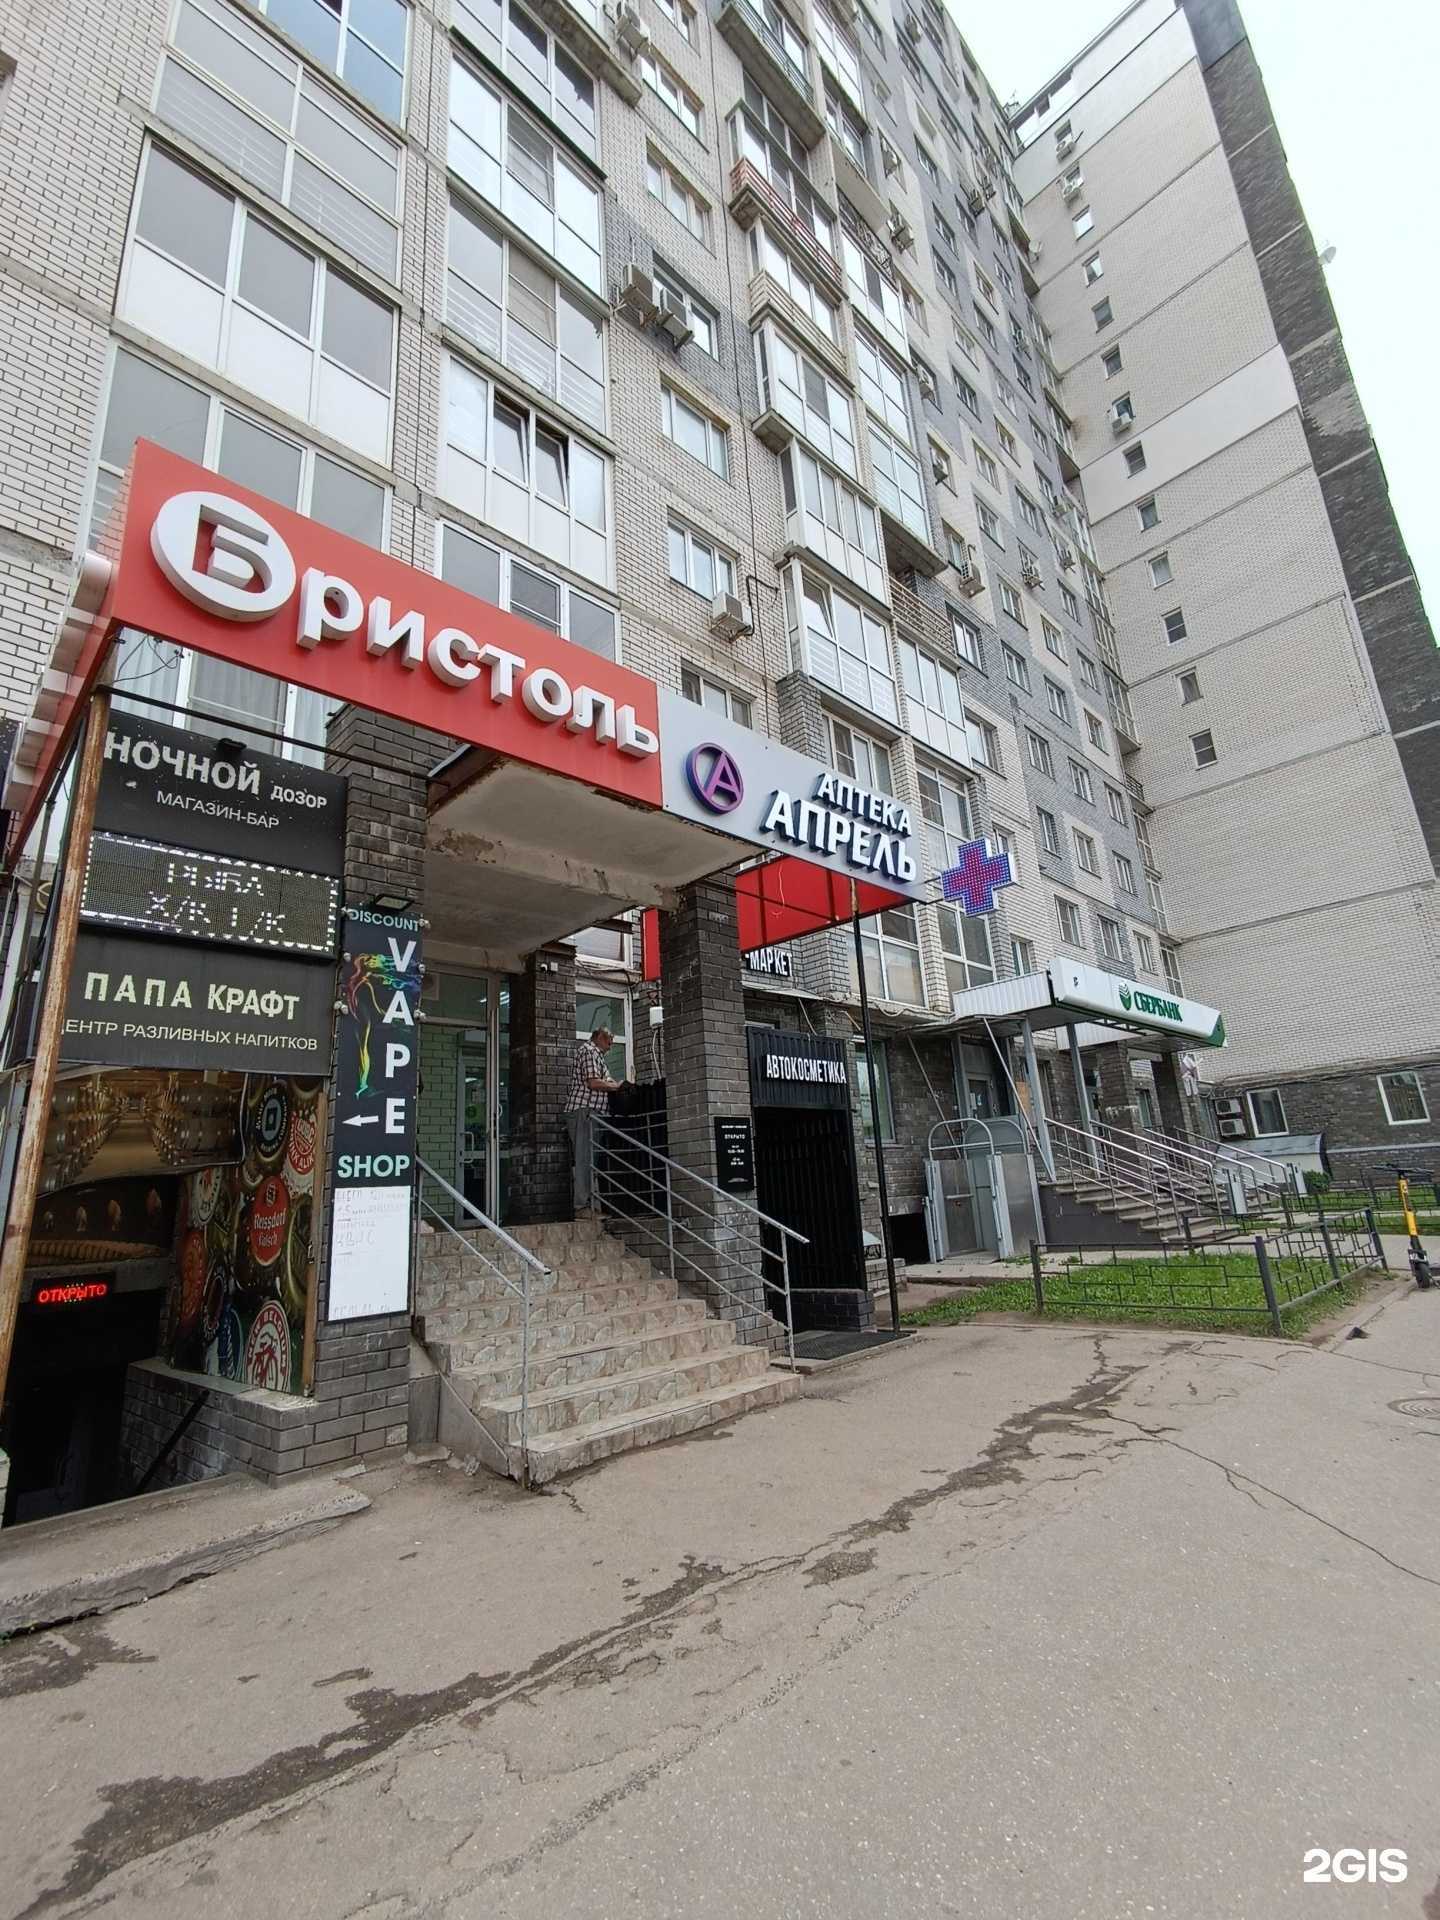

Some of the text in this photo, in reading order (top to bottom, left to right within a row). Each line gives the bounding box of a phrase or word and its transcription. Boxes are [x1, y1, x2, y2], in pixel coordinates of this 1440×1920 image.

[150, 490, 659, 759] Бристоль
[103, 731, 328, 810] НОЧНОЙ ДОЗОР
[156, 790, 280, 829] МАГАЗИН-БАР
[812, 772, 913, 837] АПТЕКА
[760, 789, 918, 884] АПРЕЛЬ
[350, 908, 420, 932] DISCOUNT
[84, 971, 300, 1020] ПАПА КРАФТ
[1133, 990, 1183, 1022] СБЕРБАНК
[61, 1018, 318, 1051] ЕНТР РАЗЛИВНЫХ НАПИТКОВ
[382, 937, 417, 1134] VAPE
[766, 1054, 847, 1084] АВТОКОСМЕТИКА
[337, 1154, 411, 1179] SHOP
[38, 1283, 107, 1303] ОТКРЫТО
